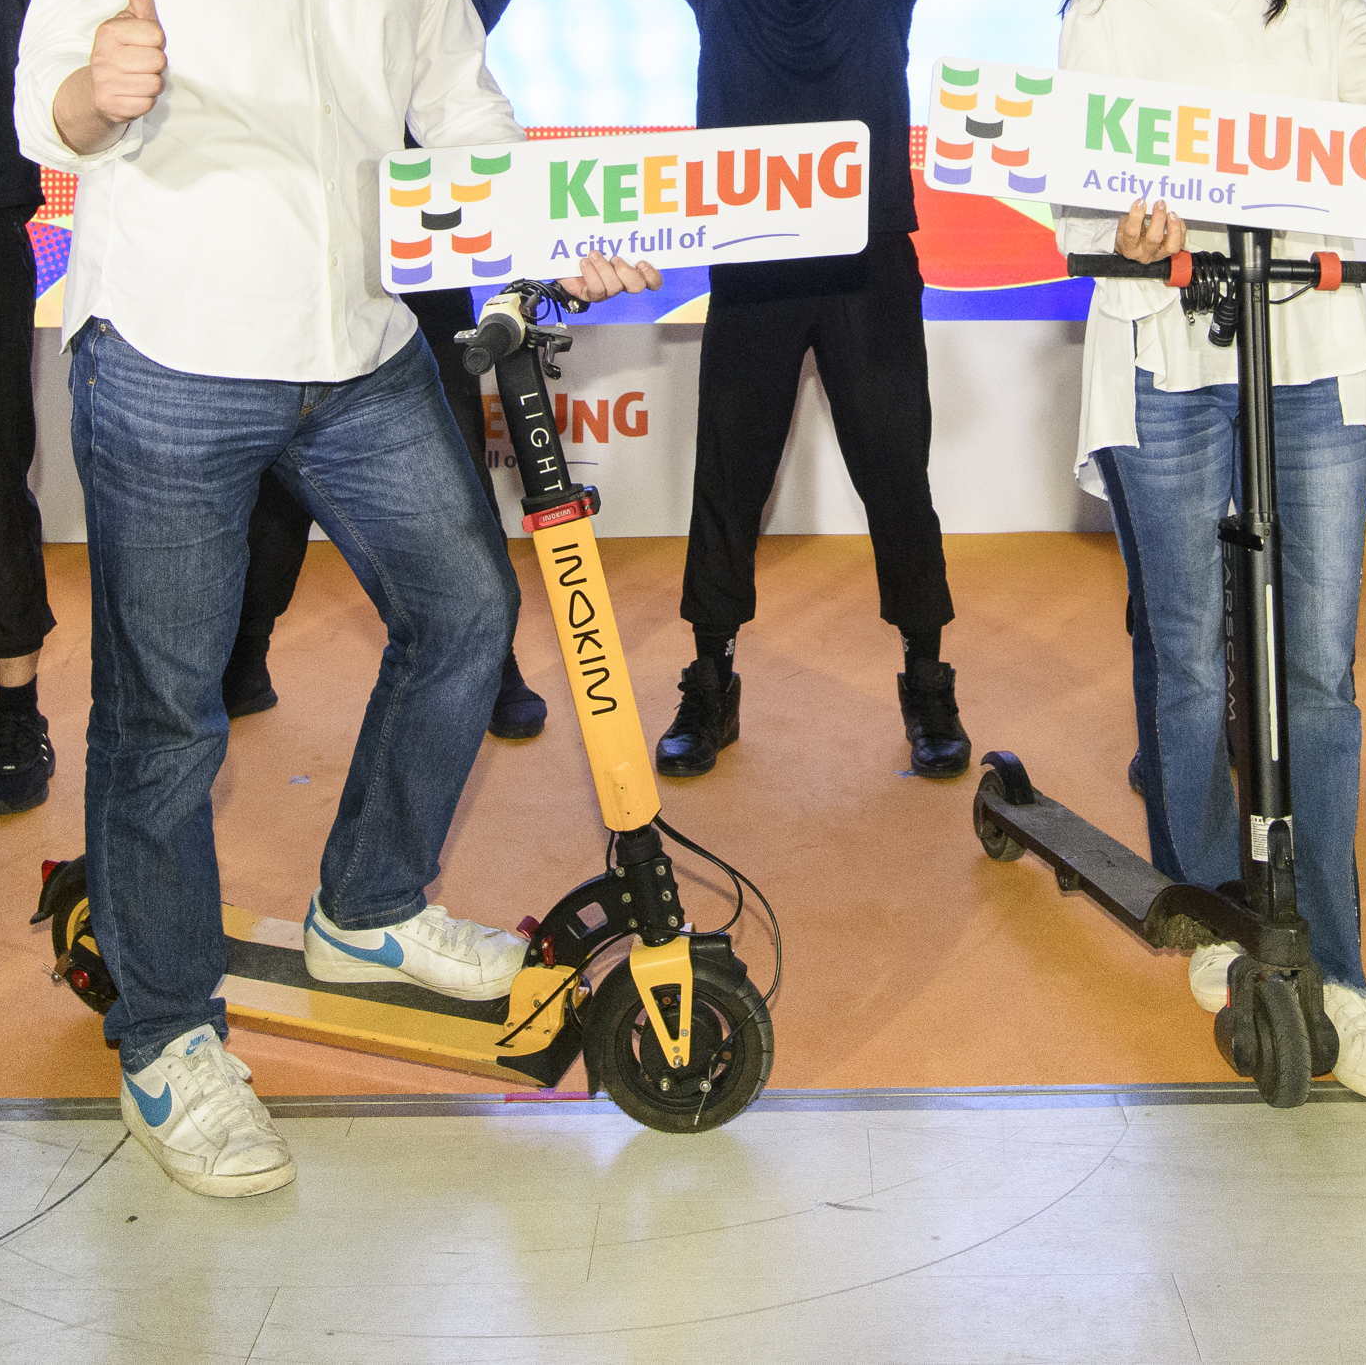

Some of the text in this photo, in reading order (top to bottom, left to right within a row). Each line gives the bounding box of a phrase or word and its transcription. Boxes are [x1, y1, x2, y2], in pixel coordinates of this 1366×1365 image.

[550, 140, 863, 224] KEELUNG
[1083, 170, 1236, 206] A city full of
[550, 225, 708, 261] A city full of
[519, 392, 563, 492] LIGHT
[542, 508, 572, 523] INOKIM
[552, 542, 618, 717] INOKIM
[189, 1033, 206, 1048] NIKE
